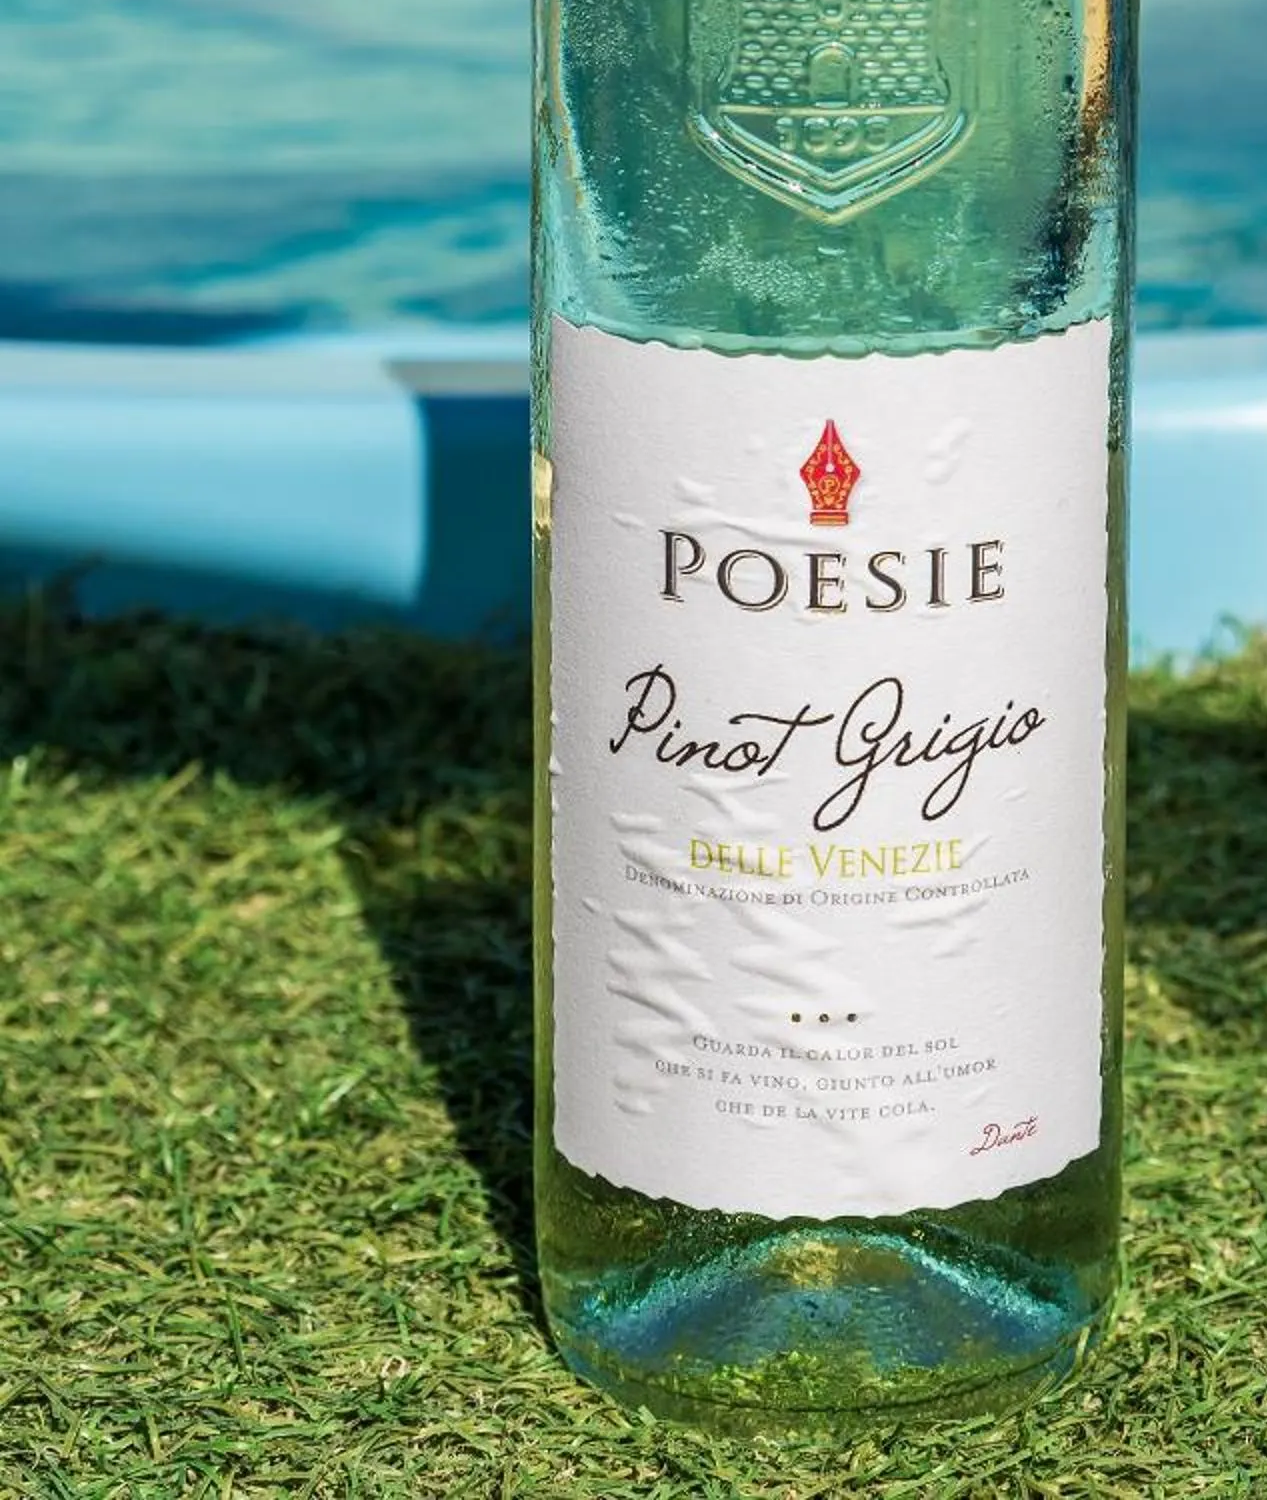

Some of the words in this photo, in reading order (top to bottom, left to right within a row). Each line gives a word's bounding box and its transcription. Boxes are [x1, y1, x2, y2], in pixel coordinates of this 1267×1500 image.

[658, 529, 1006, 614] POESIE
[609, 664, 836, 777] Pinot
[813, 676, 1046, 832] Grigio
[690, 837, 793, 879] DELLE
[808, 838, 963, 880] VENEZIE
[782, 891, 803, 906] DI
[810, 888, 898, 906] ORIGINE
[904, 867, 1031, 902] CONTROLLATA
[692, 1034, 772, 1058] GUARDA
[805, 1046, 874, 1062] CALOR
[881, 1043, 919, 1059] DEL
[925, 1036, 959, 1054] SOL
[655, 1059, 691, 1078] CHE
[696, 1067, 714, 1081] SI
[721, 1071, 742, 1086] FA
[750, 1075, 808, 1092] VINO,
[815, 1074, 896, 1092] GIUNTO
[902, 1057, 999, 1087] ALL'UMOR
[715, 1099, 754, 1116] CHE
[763, 1104, 787, 1118] DE
[795, 1106, 818, 1120] LA
[826, 1105, 871, 1122] VITE
[878, 1098, 937, 1119] COLA.
[969, 1114, 1039, 1157] Dante
